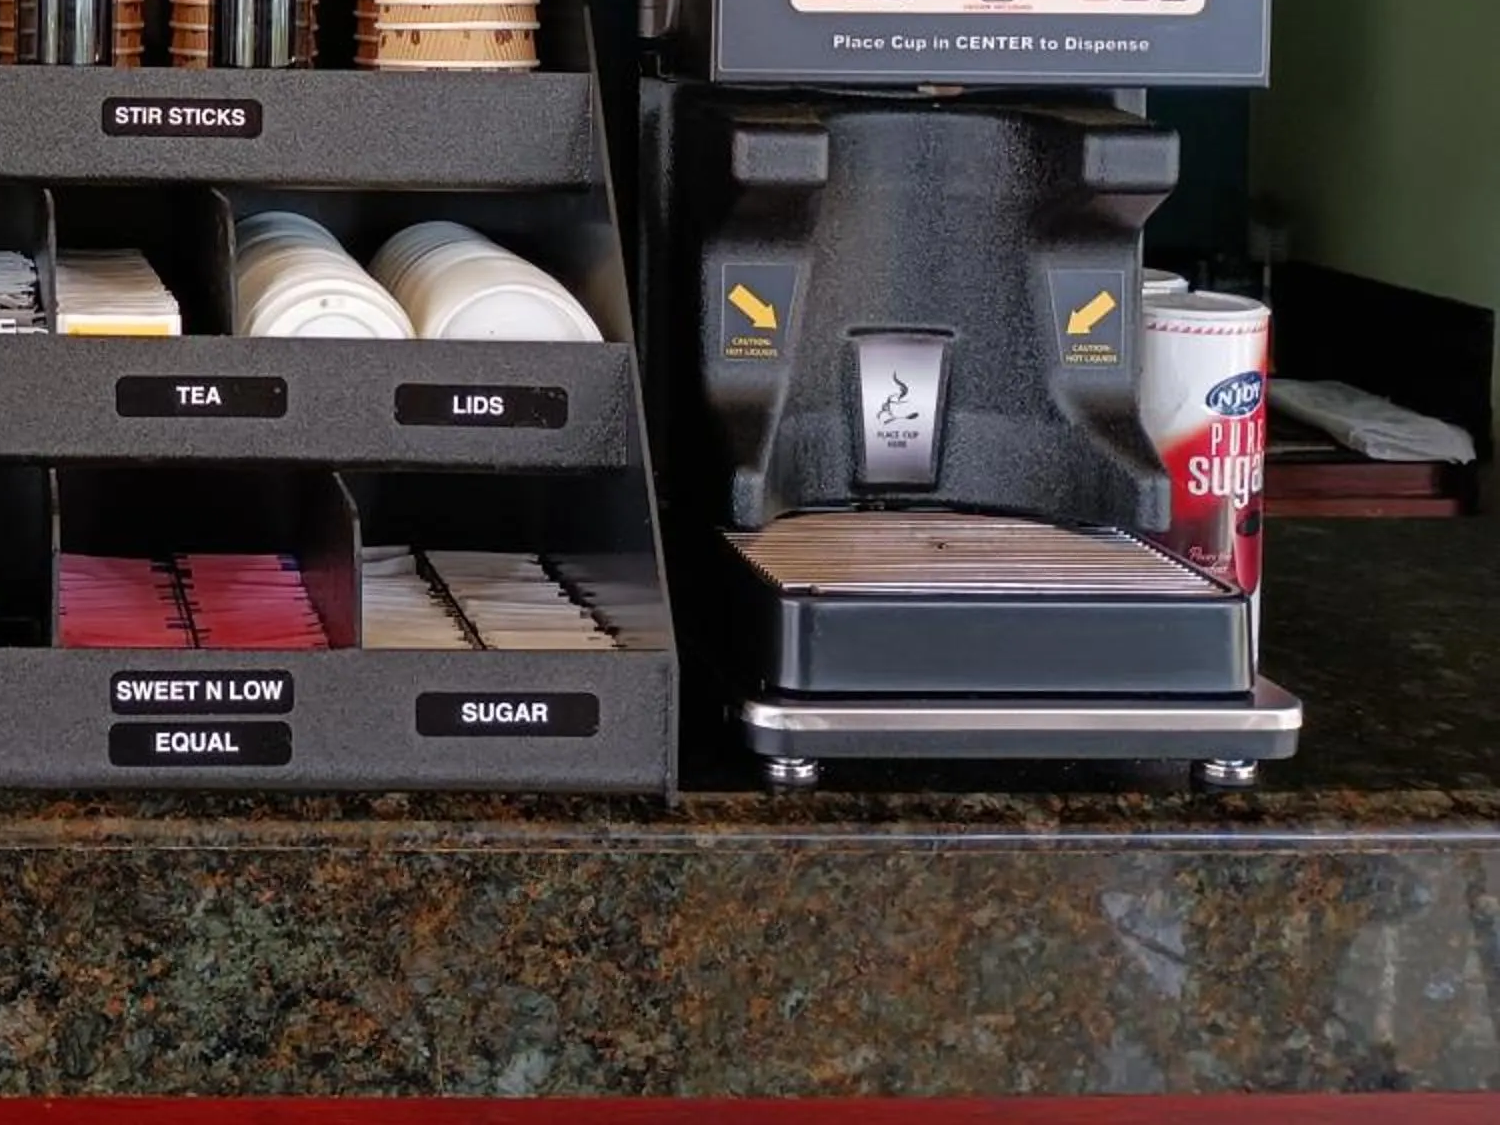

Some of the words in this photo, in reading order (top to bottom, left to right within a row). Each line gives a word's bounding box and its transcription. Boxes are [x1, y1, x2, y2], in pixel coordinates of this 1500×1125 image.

[833, 34, 885, 50] Place
[891, 35, 927, 52] Cup
[932, 35, 950, 49] in
[956, 36, 1033, 50] CENTER
[1040, 37, 1059, 50] to
[1065, 37, 1150, 53] Dispense
[115, 106, 163, 124] STIR
[168, 107, 246, 126] STICKS
[176, 386, 221, 404] TEA
[453, 395, 504, 415] LIDS
[1210, 419, 1264, 455] PURE
[1188, 453, 1264, 509] suga
[117, 680, 200, 701] SWEET
[206, 680, 222, 700] N
[229, 680, 283, 700] LOW
[462, 702, 548, 723] SUGAR
[155, 732, 239, 752] EQUAL
